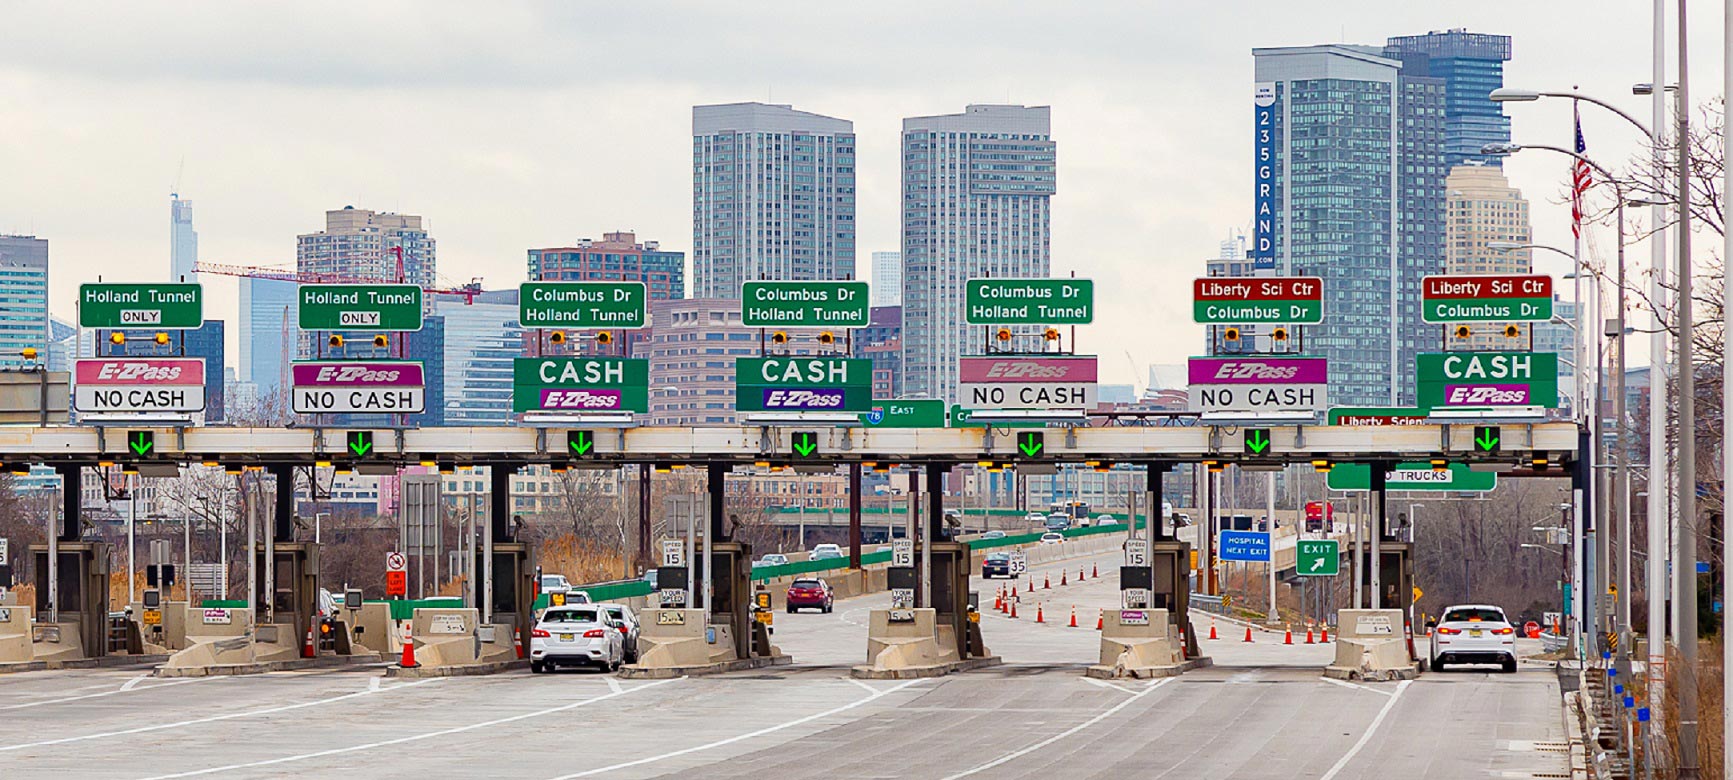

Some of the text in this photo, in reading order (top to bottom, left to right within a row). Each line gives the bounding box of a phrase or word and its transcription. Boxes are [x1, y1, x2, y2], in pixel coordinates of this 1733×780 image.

[755, 288, 855, 301] Columbus Dr
[979, 285, 1079, 298] Columbus Dr
[1201, 283, 1313, 298] Liberty Sci Ctr
[1431, 280, 1544, 296] Liberty Sci Ctr
[86, 290, 196, 303] Holland Tunnel
[305, 292, 414, 304] Holland Tunnel
[533, 289, 632, 302] Columbus Dr
[122, 311, 159, 322] ONLY
[526, 308, 638, 321] Holland Tunnel
[749, 308, 862, 321] Holland Tunnel
[972, 305, 1087, 318] Holland Tunnel
[1207, 305, 1308, 319] Columbus Dr
[1436, 303, 1539, 317] Columbus Dr
[341, 313, 378, 324] ONLY
[97, 363, 182, 380] E-ZPass
[539, 361, 624, 384] CASH
[761, 360, 848, 383] CASH
[986, 362, 1070, 378] E-ZPass
[1214, 362, 1299, 379] E-ZPass
[1443, 355, 1531, 378] CASH
[316, 366, 400, 382] E-ZPass
[94, 390, 184, 407] NO CASH
[305, 391, 412, 409] NO CASH
[543, 391, 618, 407] E-ZPass
[766, 390, 842, 407] E-ZPass
[973, 387, 1086, 404] NO CASH
[1201, 388, 1314, 406] NO CASH
[1449, 387, 1526, 403] E-ZPass
[870, 411, 881, 420] 78
[890, 405, 914, 415] EAST
[1341, 416, 1431, 426] Liberty Scien
[1399, 471, 1447, 481] TRUCKS
[1228, 537, 1266, 545] HOSPITAL
[1226, 547, 1267, 556] NEXT EXIT
[1304, 544, 1331, 554] EXIT
[666, 554, 680, 564] 15
[896, 553, 910, 564] 15
[1130, 554, 1144, 564] 15
[1011, 561, 1025, 572] 35
[657, 612, 668, 622] 15
